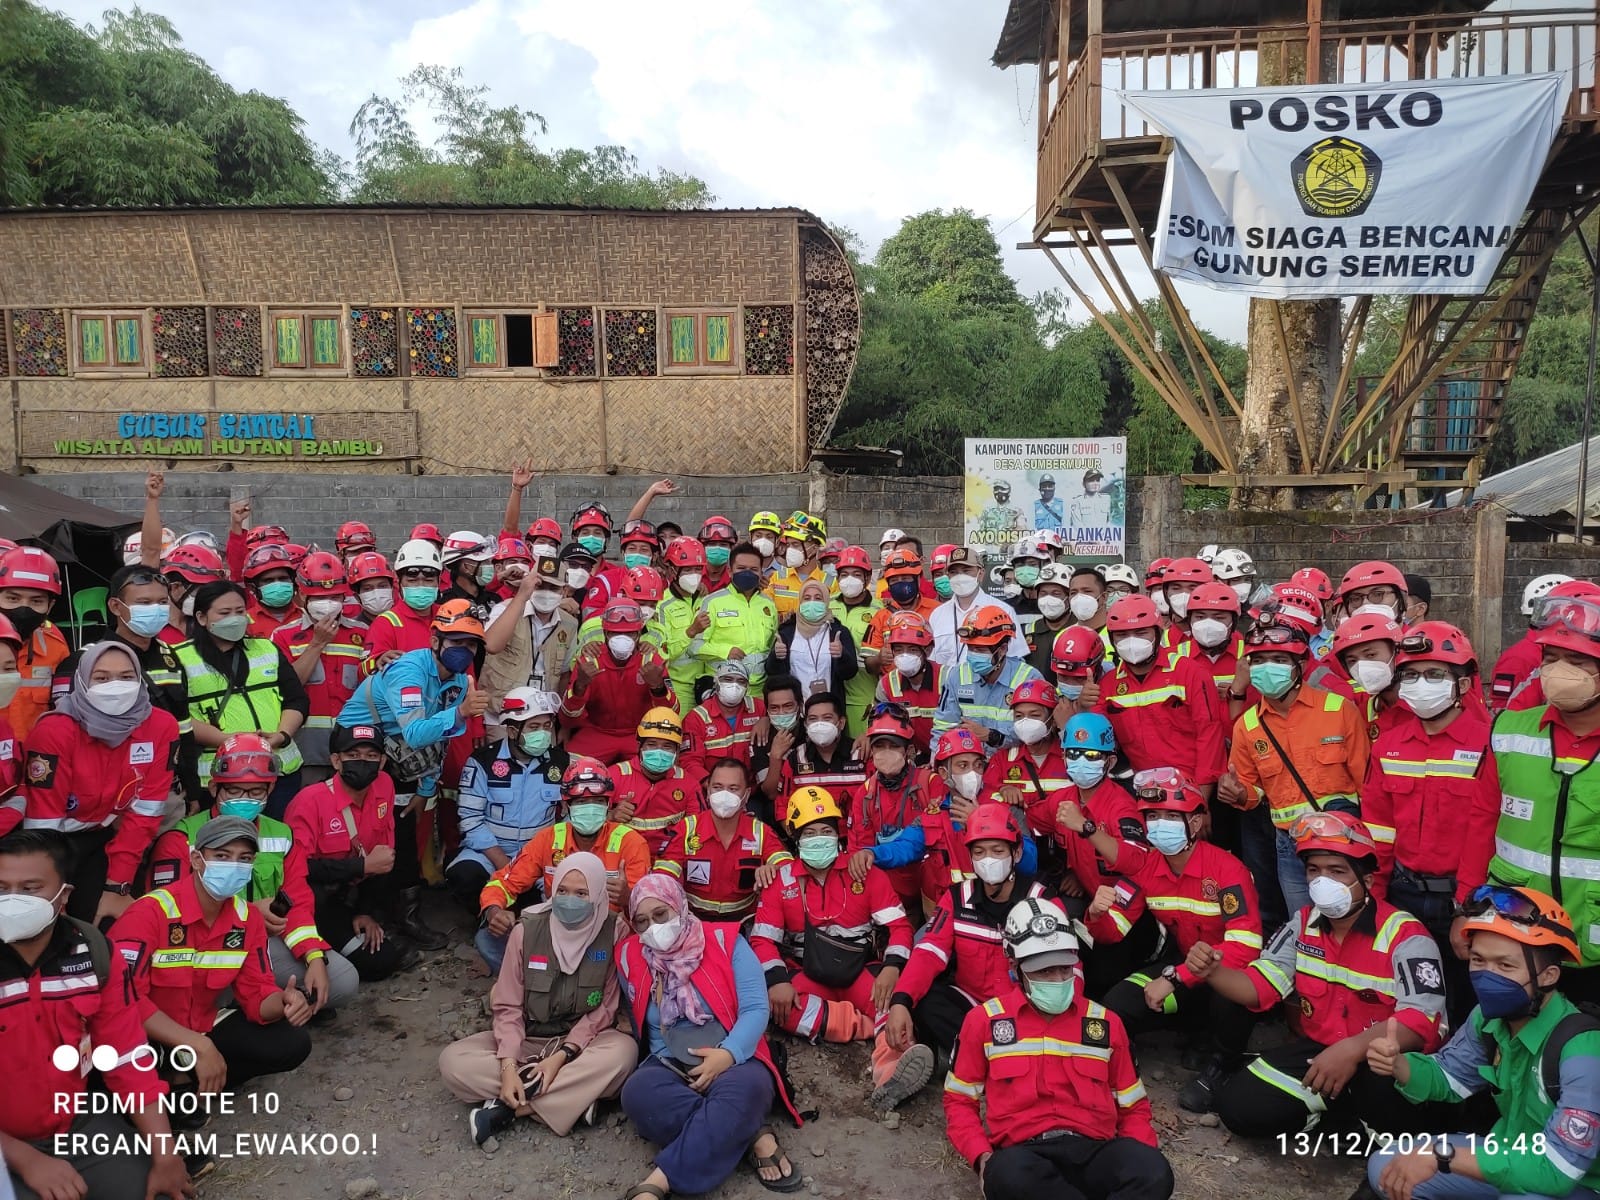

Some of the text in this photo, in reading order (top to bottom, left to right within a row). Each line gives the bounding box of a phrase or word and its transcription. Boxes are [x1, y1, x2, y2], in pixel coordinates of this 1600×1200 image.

[1229, 92, 1443, 132] POSKO
[1304, 197, 1316, 210] DAN
[1317, 206, 1346, 216] SUMBER
[1346, 199, 1363, 213] DAYA
[1361, 172, 1375, 201] MINERAL
[1167, 214, 1512, 250] ESDM SIAGA BENCANA
[1193, 246, 1475, 278] GUNUNG SEMERU
[117, 412, 207, 439] GUBUK
[54, 439, 384, 456] WISATA ALAM HUTAN BAMBU
[975, 443, 1023, 455] KAMPUNG
[1025, 443, 1069, 454] TANGGUH
[1071, 443, 1100, 454] COVID
[1112, 443, 1123, 454] 19
[994, 458, 1102, 471] DESA SUMBERMUJUR
[969, 529, 997, 545] AYO
[1075, 545, 1120, 555] KESEHATAN
[1065, 640, 1075, 653] 2
